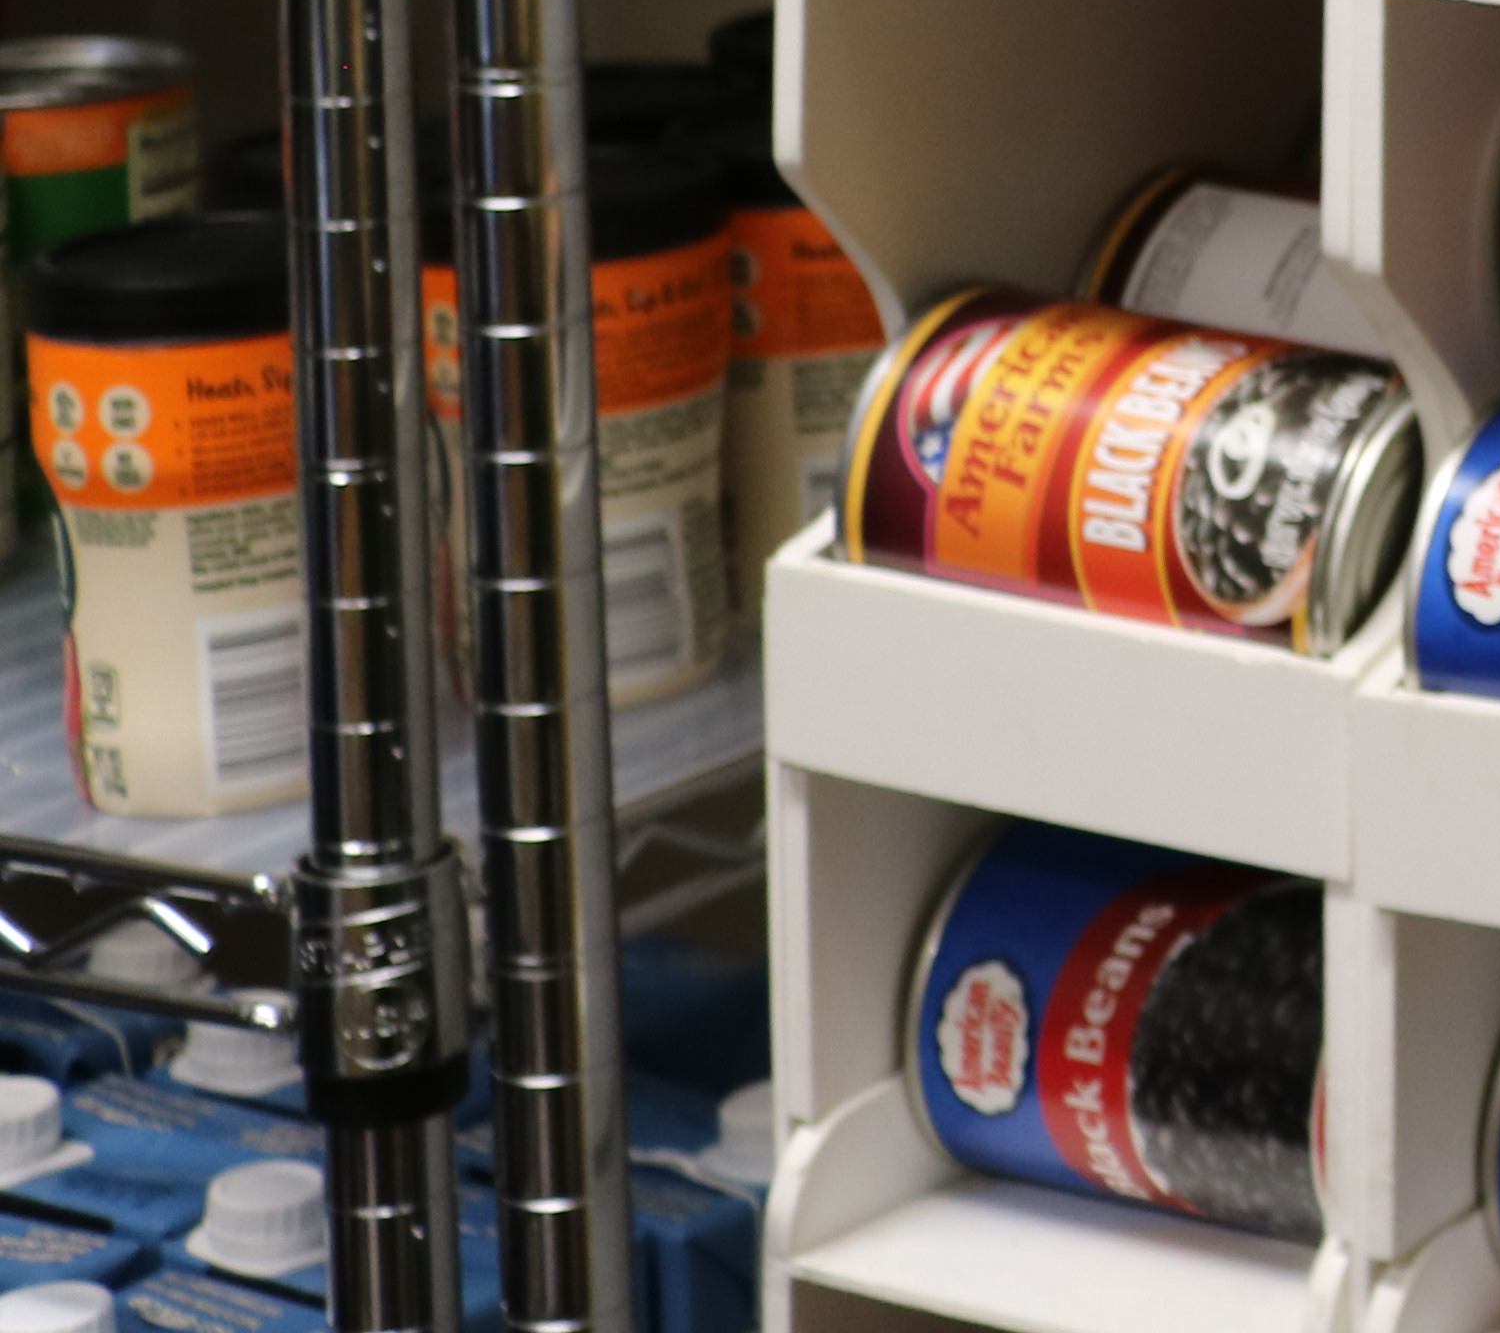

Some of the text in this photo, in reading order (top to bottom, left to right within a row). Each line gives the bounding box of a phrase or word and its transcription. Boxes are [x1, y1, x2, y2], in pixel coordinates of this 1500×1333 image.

[1083, 339, 1249, 553] BLACK BEANS
[1065, 903, 1175, 1065] Beans
